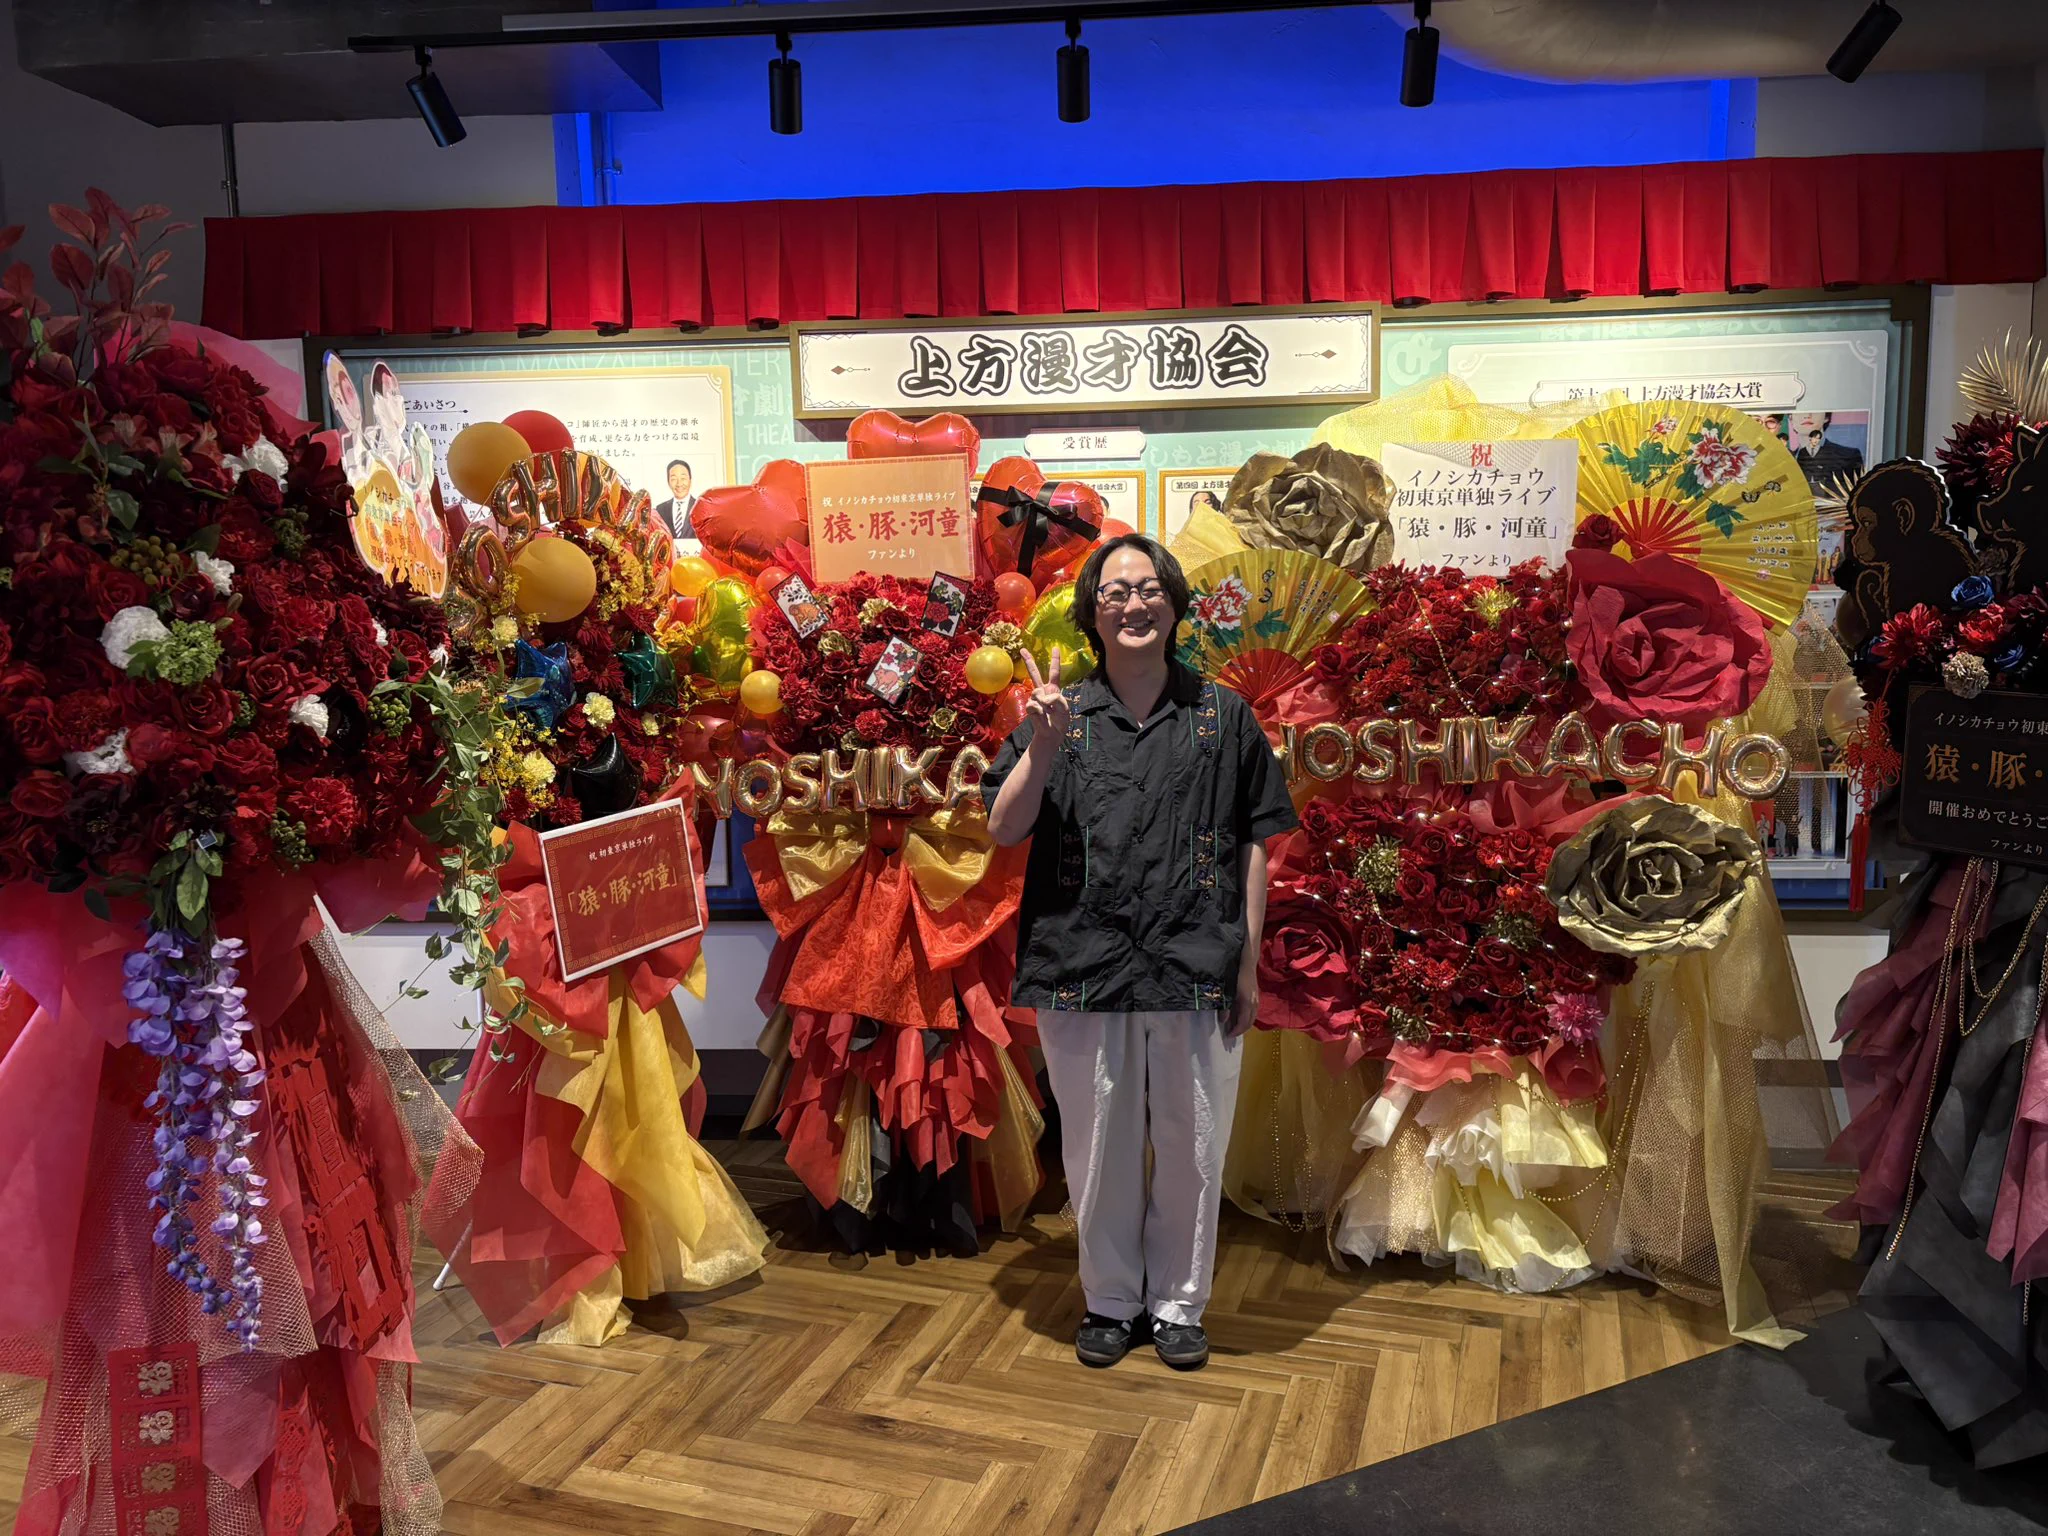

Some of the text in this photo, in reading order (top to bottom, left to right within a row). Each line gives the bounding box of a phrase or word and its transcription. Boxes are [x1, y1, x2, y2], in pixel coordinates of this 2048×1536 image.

[900, 325, 1268, 396] 上方漫才協会
[1642, 381, 1762, 401] 上方漫才協会大賞
[403, 399, 457, 411] ごあいさつ
[1062, 435, 1108, 450] 受賞歴
[1471, 443, 1494, 467] 祝
[1407, 468, 1544, 487] イノシカチョウ
[822, 491, 956, 508] 祝 イノシカチョウ初東京単独ライブ
[1396, 486, 1557, 507] 初東京単独ライブ
[822, 507, 960, 544] 猿・豚・河童
[1399, 516, 1558, 540] 「猿・豚・河童」
[868, 548, 916, 561] ファンより
[1441, 552, 1512, 567] ファンより
[588, 834, 654, 862] 祝 初東京単独ライブ
[1990, 839, 2043, 856] ファンより
[567, 862, 678, 917] 「猿・豚・河童」
